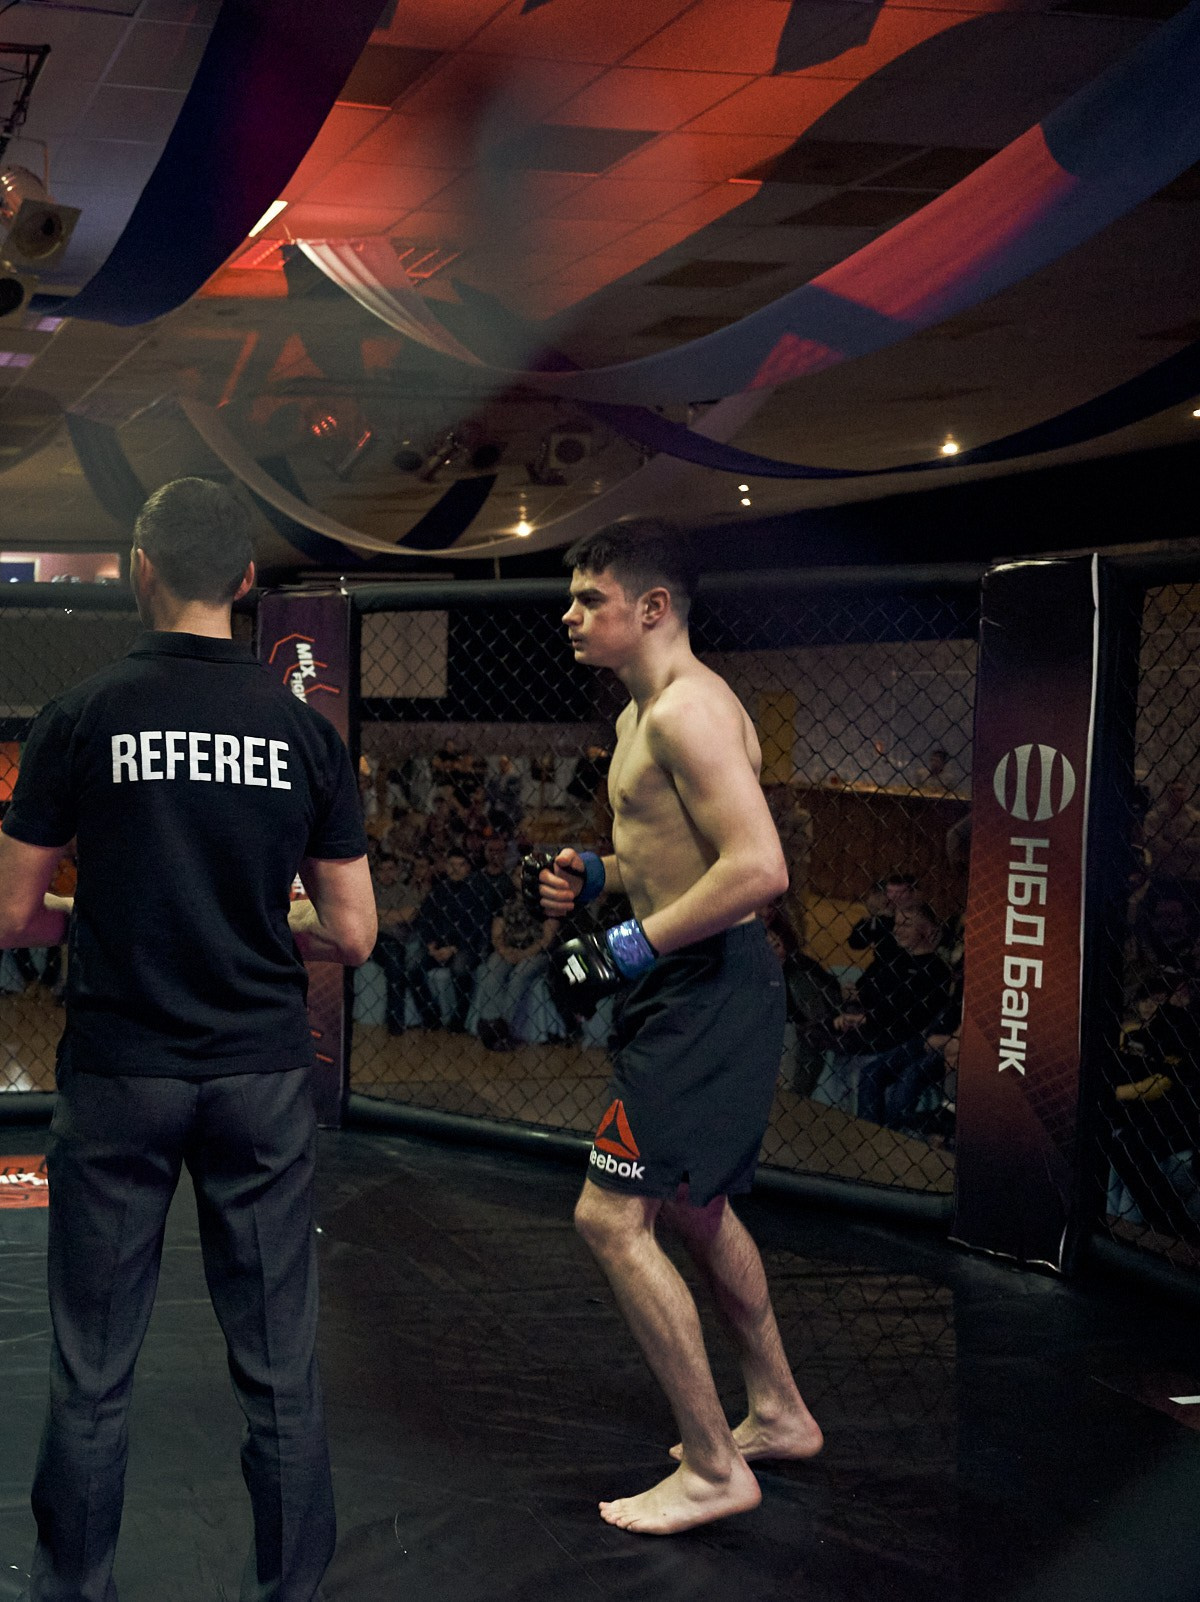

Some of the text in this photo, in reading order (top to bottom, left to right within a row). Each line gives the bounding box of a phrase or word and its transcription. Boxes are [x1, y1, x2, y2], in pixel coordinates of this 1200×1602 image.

[296, 643, 317, 678] MIX
[111, 730, 292, 790] REFEREE
[997, 838, 1050, 1076] НБД Банк
[589, 1144, 646, 1180] eebok
